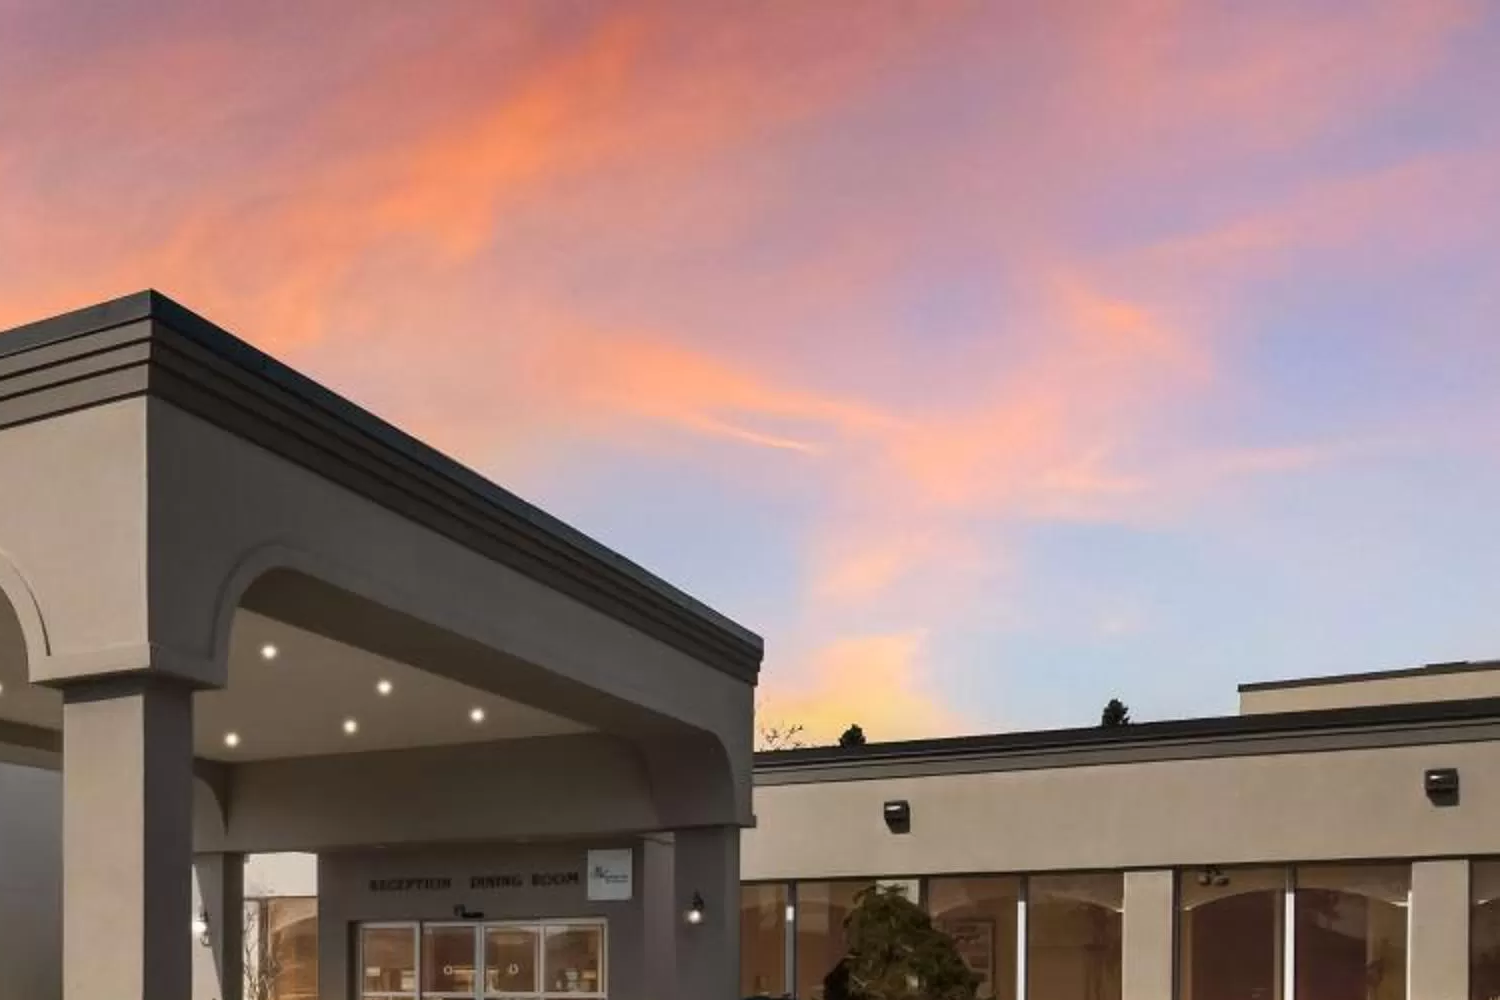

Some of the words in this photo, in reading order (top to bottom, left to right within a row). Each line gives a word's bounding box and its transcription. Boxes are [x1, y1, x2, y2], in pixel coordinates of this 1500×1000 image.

[369, 877, 452, 892] RECEPTION
[470, 875, 523, 889] DINING
[532, 871, 579, 886] ROOM
